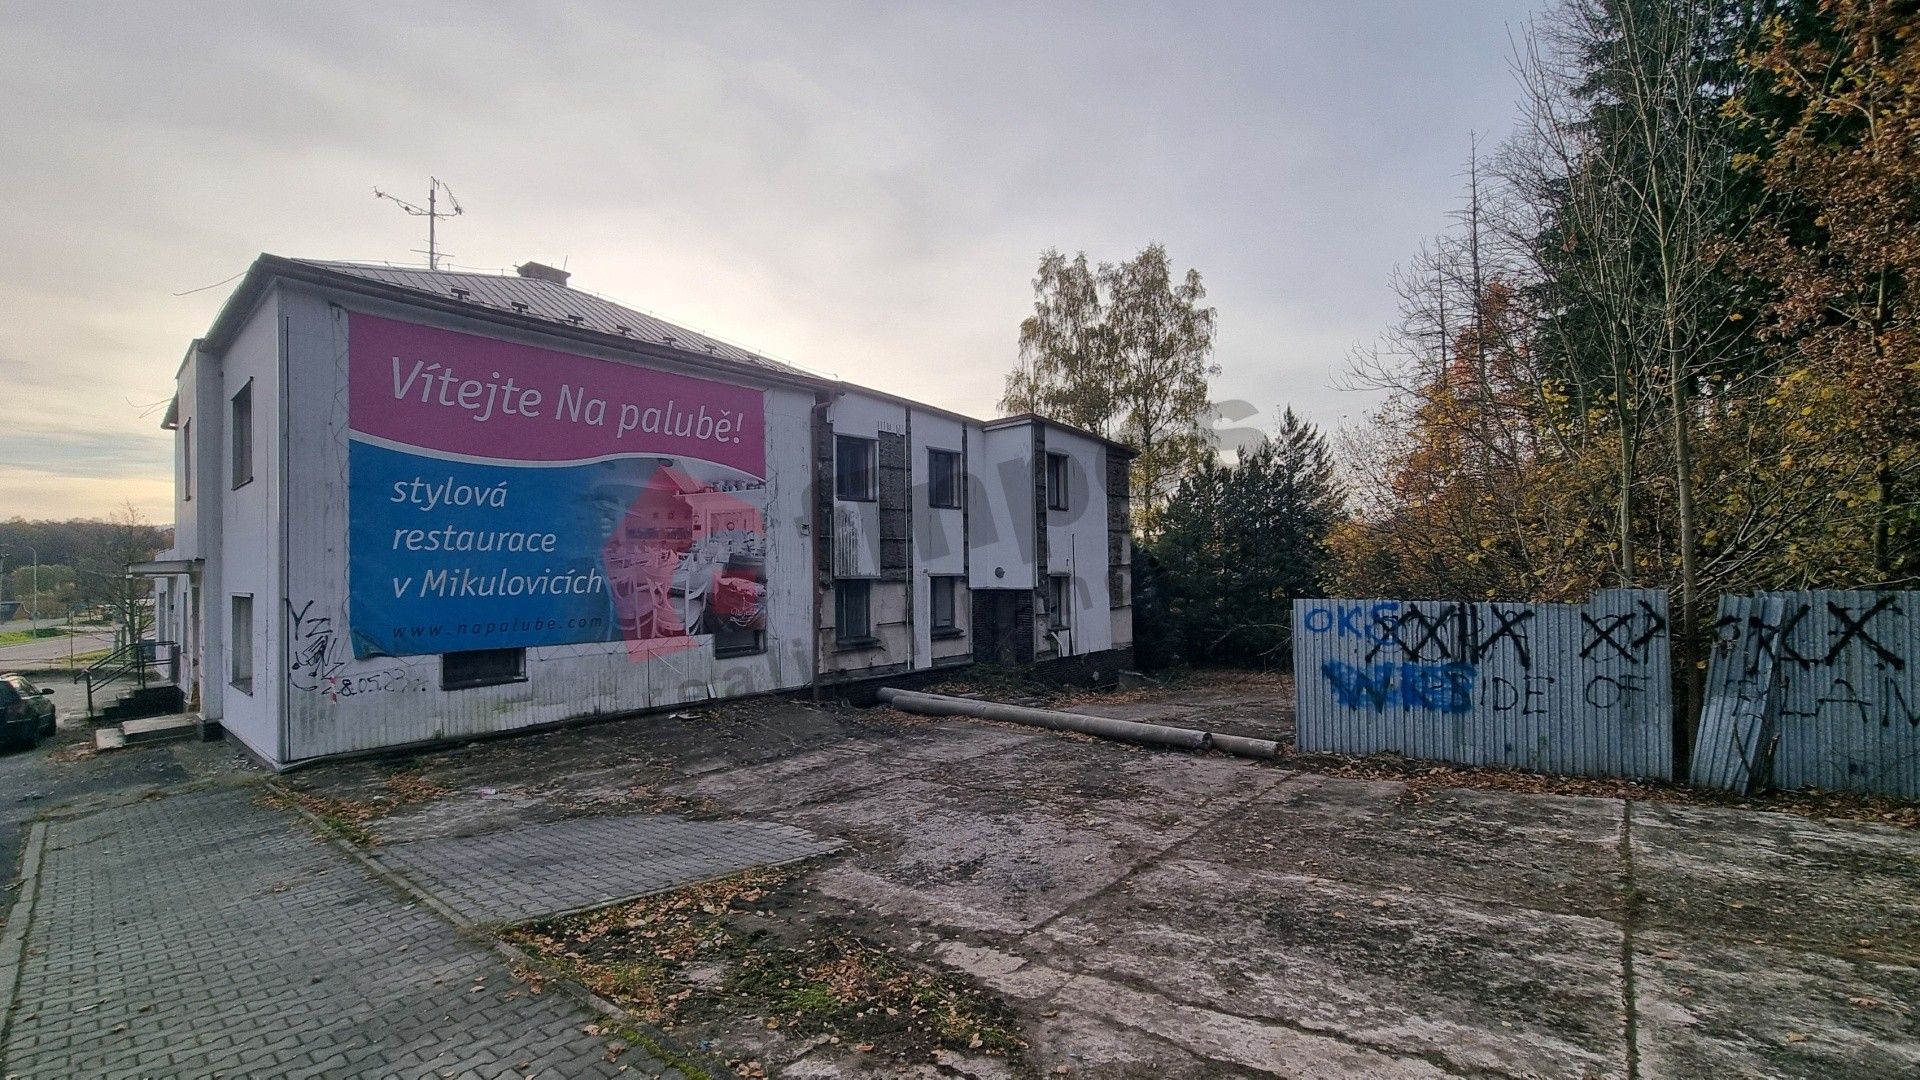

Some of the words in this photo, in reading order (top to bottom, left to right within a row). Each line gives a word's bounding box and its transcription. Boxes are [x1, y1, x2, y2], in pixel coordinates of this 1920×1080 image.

[391, 356, 542, 422] Vítejte
[555, 384, 607, 427] Na
[617, 400, 744, 444] palubě!
[390, 475, 508, 511] stylová
[392, 525, 557, 552] restaurace
[392, 577, 409, 598] v
[420, 568, 602, 598] Mikulovicích
[391, 615, 603, 639] www.napalube.com
